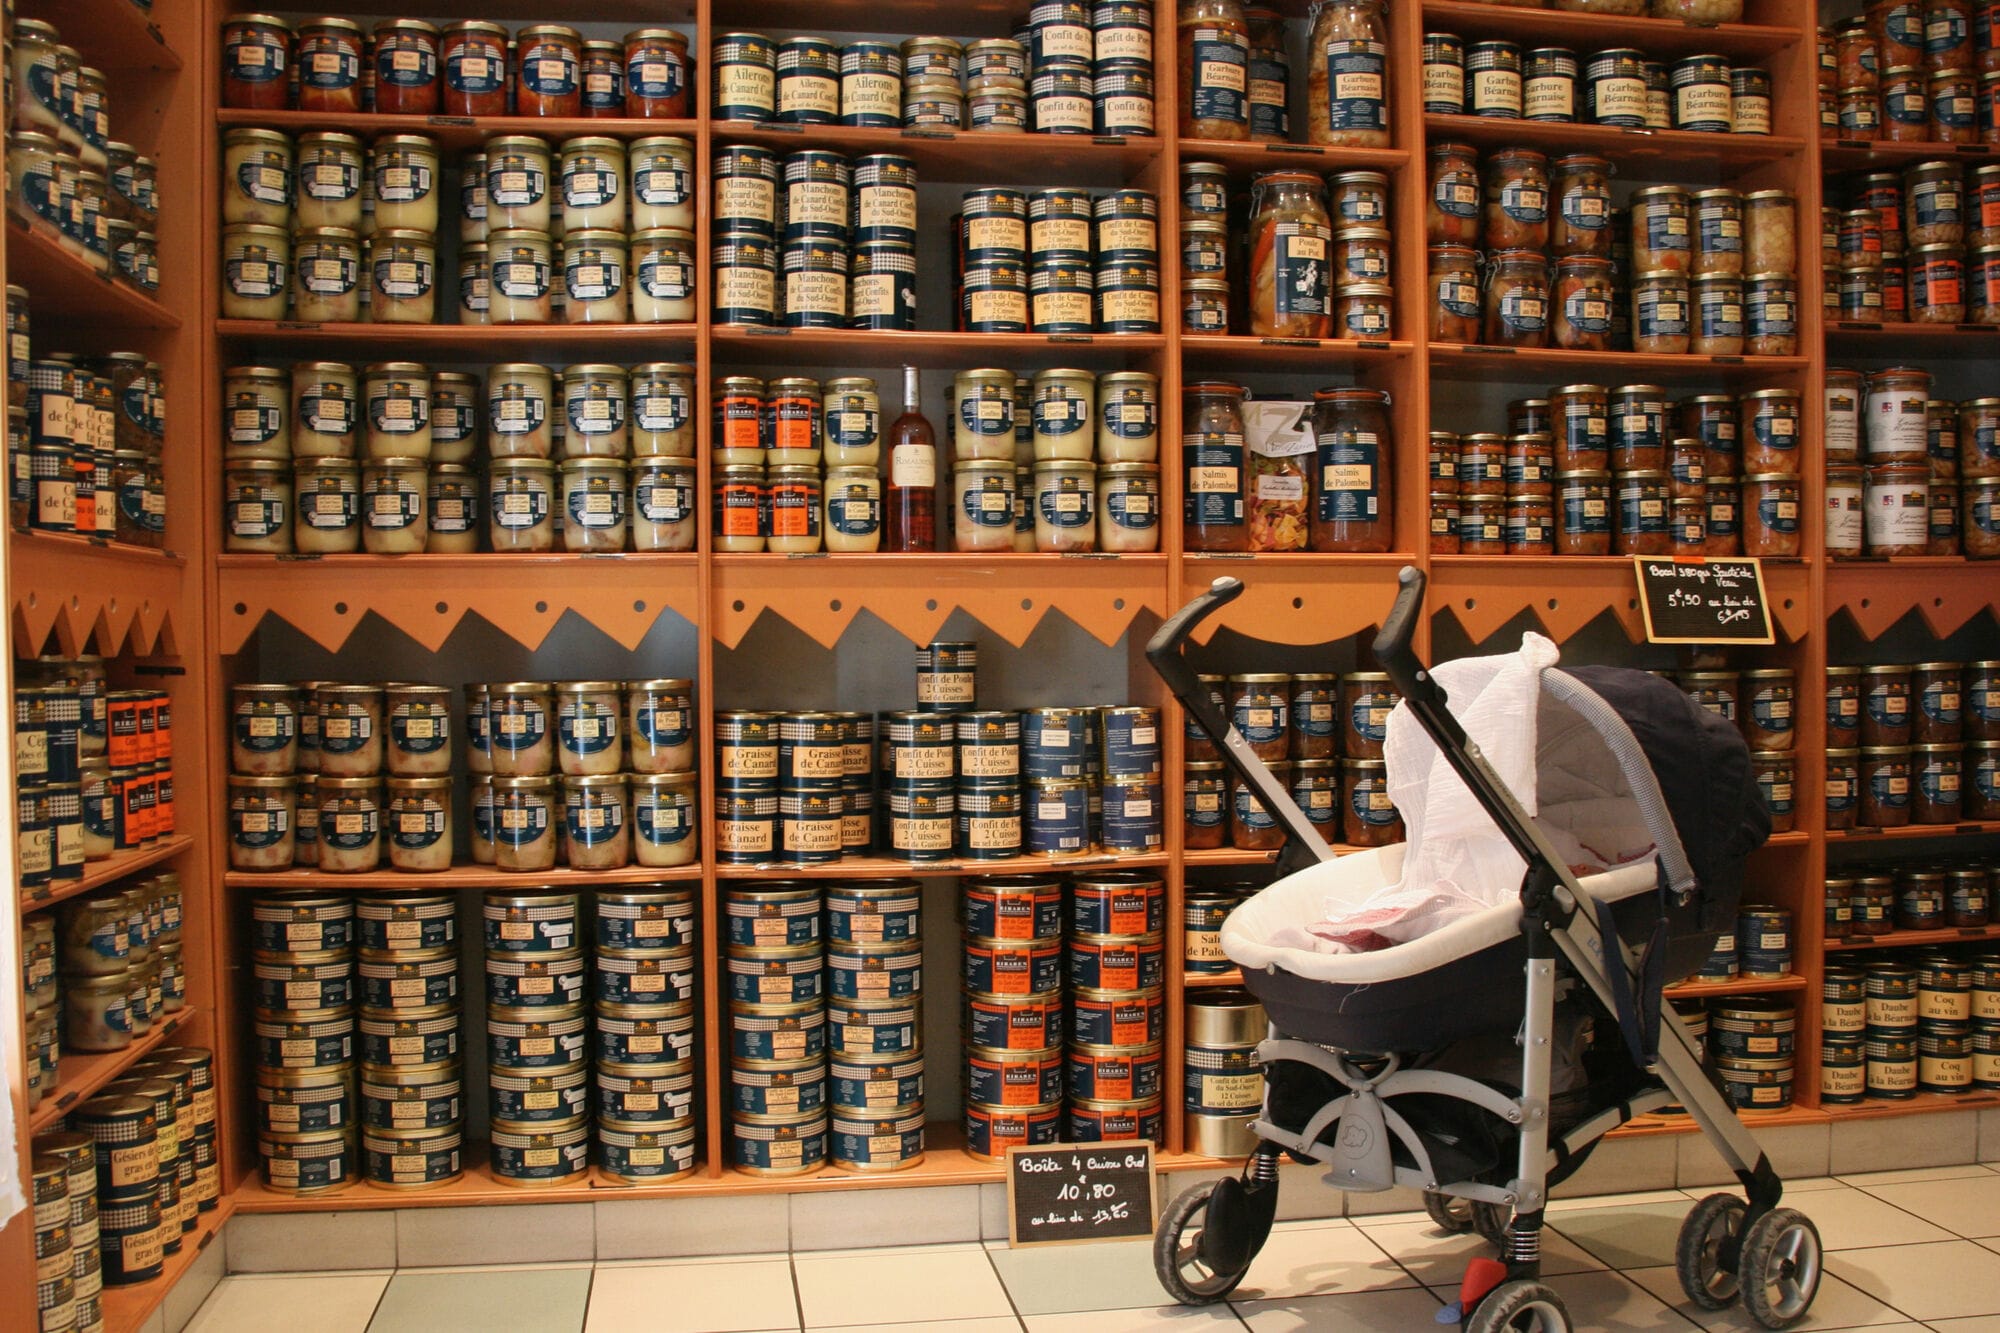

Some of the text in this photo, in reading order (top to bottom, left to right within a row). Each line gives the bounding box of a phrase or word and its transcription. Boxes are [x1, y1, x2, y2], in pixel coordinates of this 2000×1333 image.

[1045, 30, 1074, 41] Confit
[1097, 33, 1136, 45] Confit de
[734, 68, 771, 83] Ailerons
[799, 79, 827, 89] Ailerons
[854, 76, 893, 90] Ailerons
[730, 83, 760, 95] Canard
[791, 90, 818, 101] Canard
[851, 90, 879, 101] Canard
[1038, 101, 1075, 113] Confit de
[1108, 102, 1135, 111] Confit
[48, 410, 63, 422] de
[1202, 471, 1227, 479] Salmis
[1335, 468, 1359, 477] Salmis
[1191, 480, 1236, 490] de Palombes
[1325, 477, 1370, 487] de Palombes
[44, 496, 60, 508] de
[1649, 564, 1676, 577] Bocal
[1708, 599, 1722, 607] au
[1742, 595, 1757, 606] de
[941, 675, 951, 683] de
[926, 684, 963, 693] 2 Cuisses
[736, 748, 772, 759] Graisse
[898, 749, 935, 759] Confit de
[963, 747, 999, 757] Confit de
[728, 759, 777, 769] de Canard
[801, 759, 813, 768] de
[915, 760, 945, 768] Cuisses
[981, 758, 1010, 766] Cuisses
[723, 822, 760, 832] Graisse
[796, 821, 834, 832] Graisse
[895, 820, 916, 830] Confit
[920, 821, 930, 830] de
[972, 820, 1010, 829] Confit de
[728, 832, 767, 843] Canard
[789, 832, 838, 843] de Canard
[904, 831, 941, 840] 2 Cuisses
[985, 830, 990, 838] 2
[1201, 934, 1221, 943] Sal
[1187, 947, 1226, 957] de Palo
[1934, 994, 1955, 1006] Coq
[1881, 1002, 1909, 1012] Daube
[1928, 1007, 1959, 1015] au vin
[1983, 1006, 1996, 1014] au
[1872, 1013, 1882, 1021] la
[1885, 1066, 1911, 1075] Daube
[1940, 1062, 1961, 1071] Coq
[1832, 1071, 1859, 1080] Daube
[1876, 1074, 1885, 1084] la
[1950, 1072, 1965, 1081] vin
[113, 1149, 147, 1163] Gésiers
[1019, 1157, 1063, 1172] Boîte
[1071, 1155, 1081, 1171] 4
[124, 1163, 143, 1177] gras
[1031, 1216, 1045, 1226] au
[1046, 1211, 1066, 1223] lieu
[1069, 1210, 1084, 1223] de
[124, 1235, 154, 1249] Gésiers
[135, 1247, 153, 1261] gras
